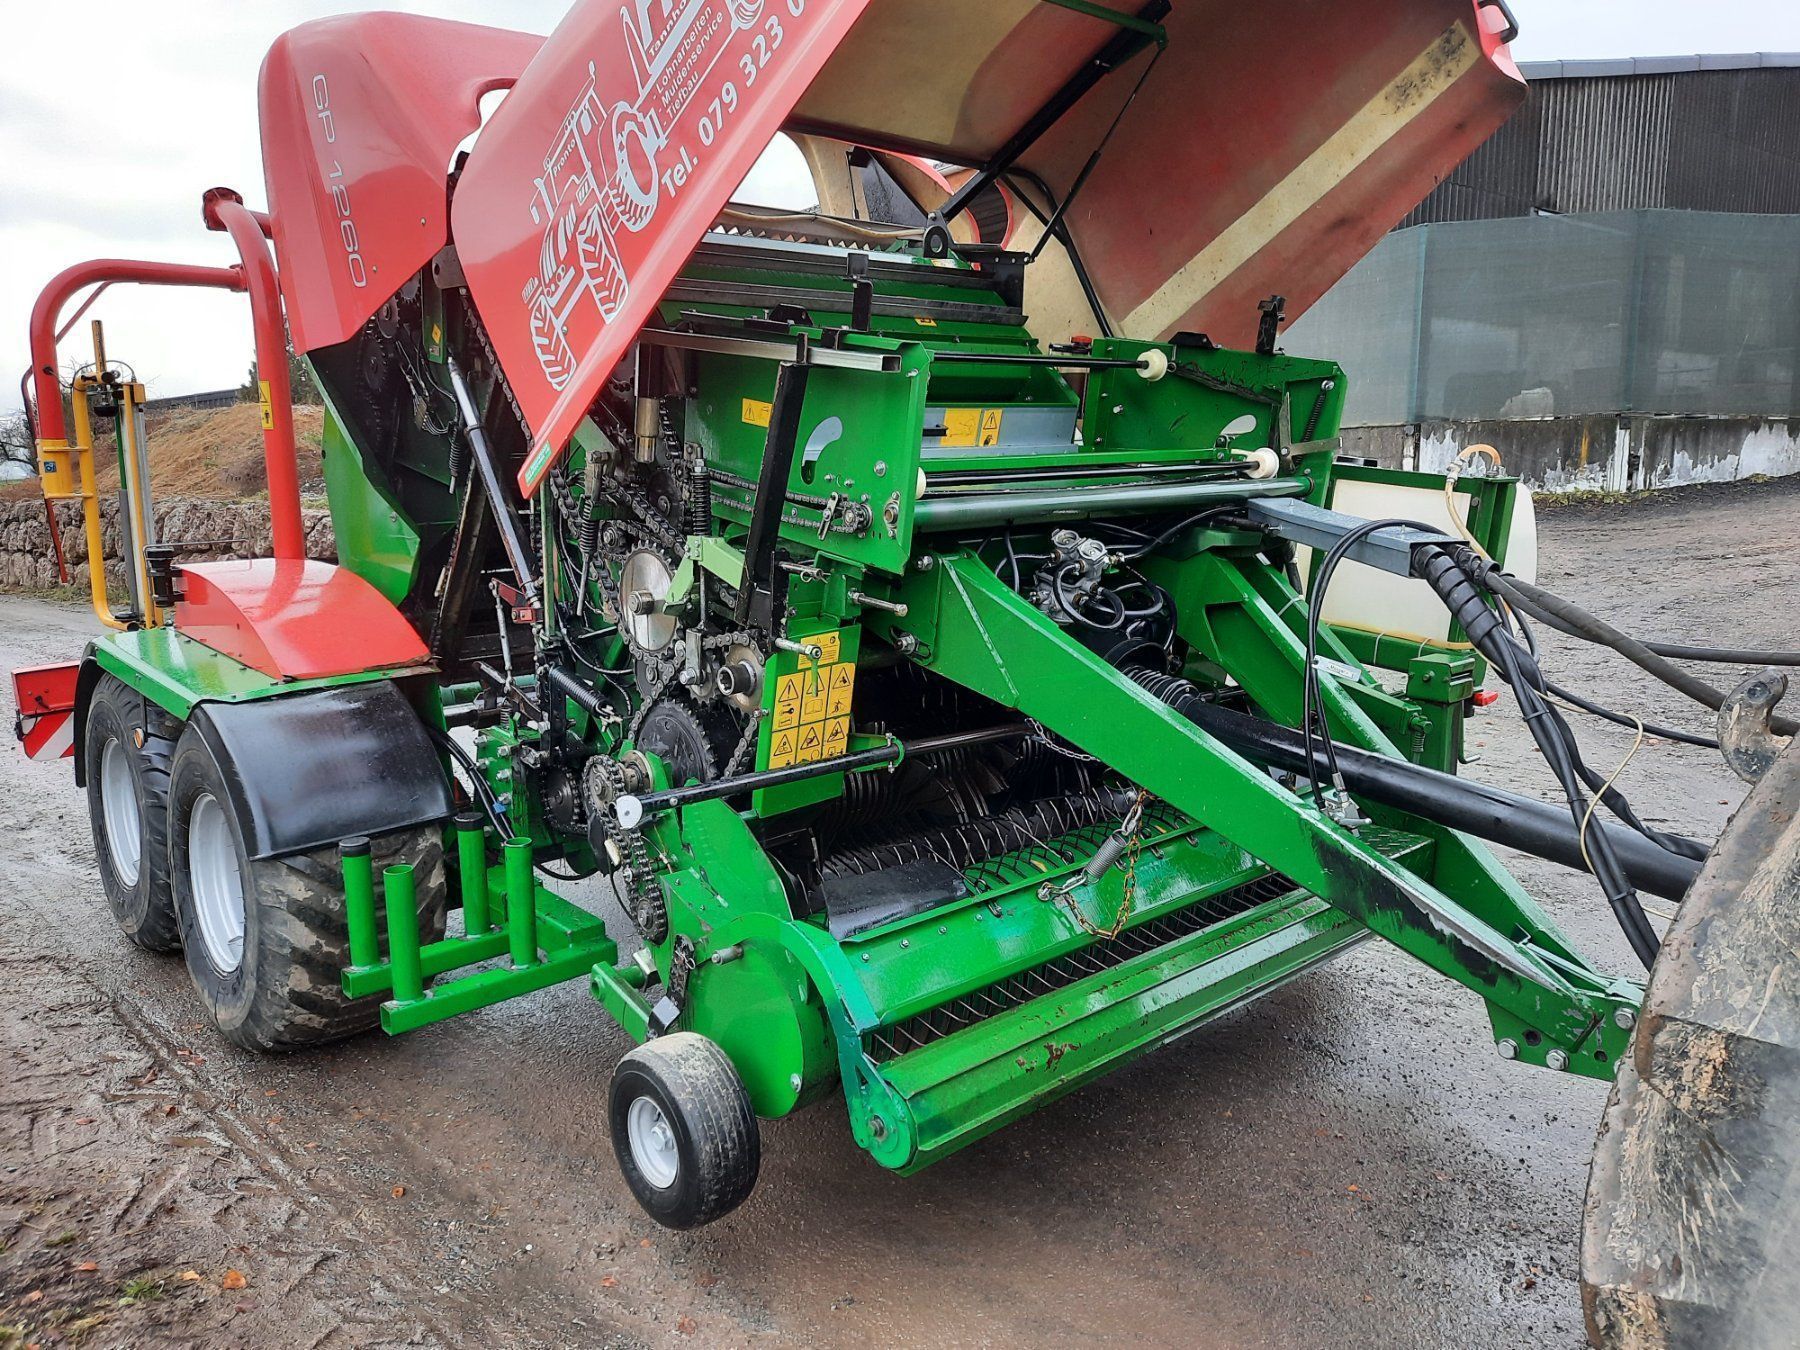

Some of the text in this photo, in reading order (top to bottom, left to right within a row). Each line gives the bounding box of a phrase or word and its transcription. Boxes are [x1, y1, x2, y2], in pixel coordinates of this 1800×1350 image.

[656, 6, 713, 93] Lohnarbeiten
[661, 11, 724, 107] Muldenservice
[661, 146, 699, 199] Tel.
[698, 81, 739, 147] 079
[738, 15, 784, 88] 323
[666, 71, 699, 120] Tiefbau
[312, 74, 367, 288] GP 1260
[553, 139, 577, 178] Pronto
